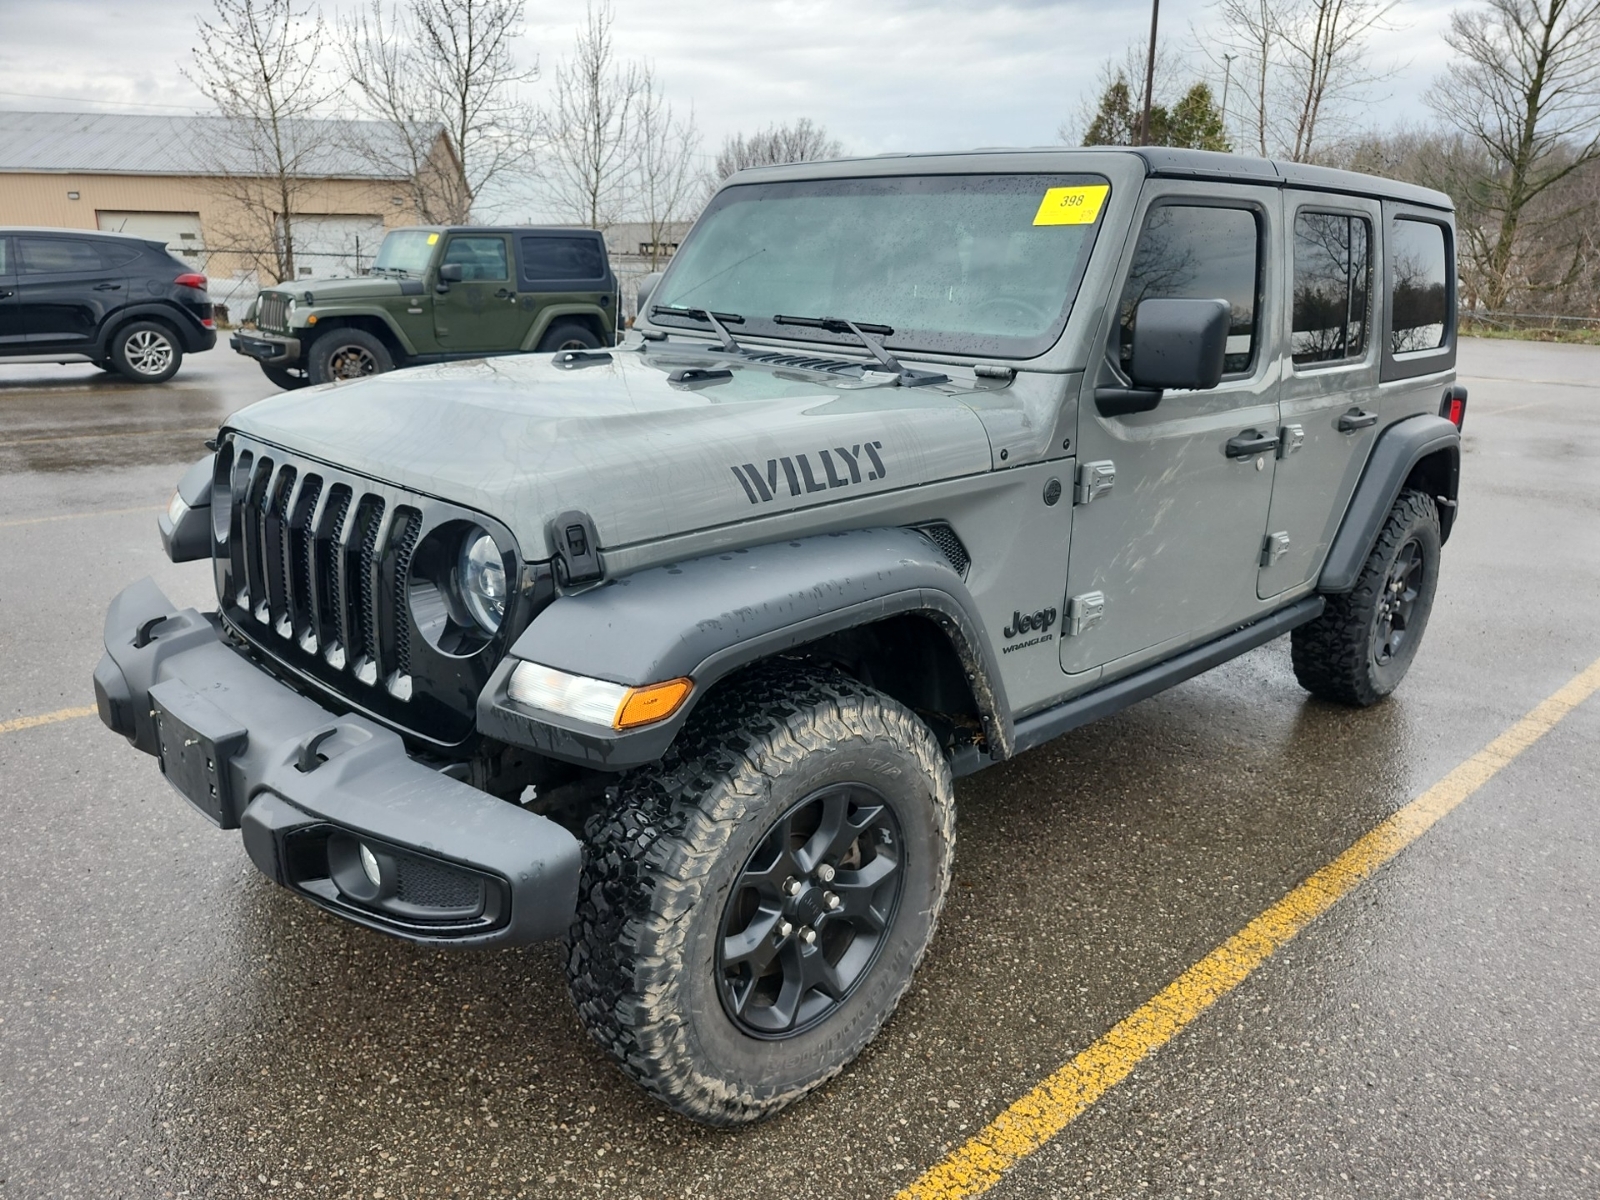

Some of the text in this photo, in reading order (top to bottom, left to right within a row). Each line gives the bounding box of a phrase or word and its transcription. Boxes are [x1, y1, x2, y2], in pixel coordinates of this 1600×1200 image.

[1060, 195, 1085, 207] 398
[730, 440, 887, 505] WILLYS
[1003, 606, 1057, 639] Jeep
[1002, 633, 1053, 654] WRANGLER
